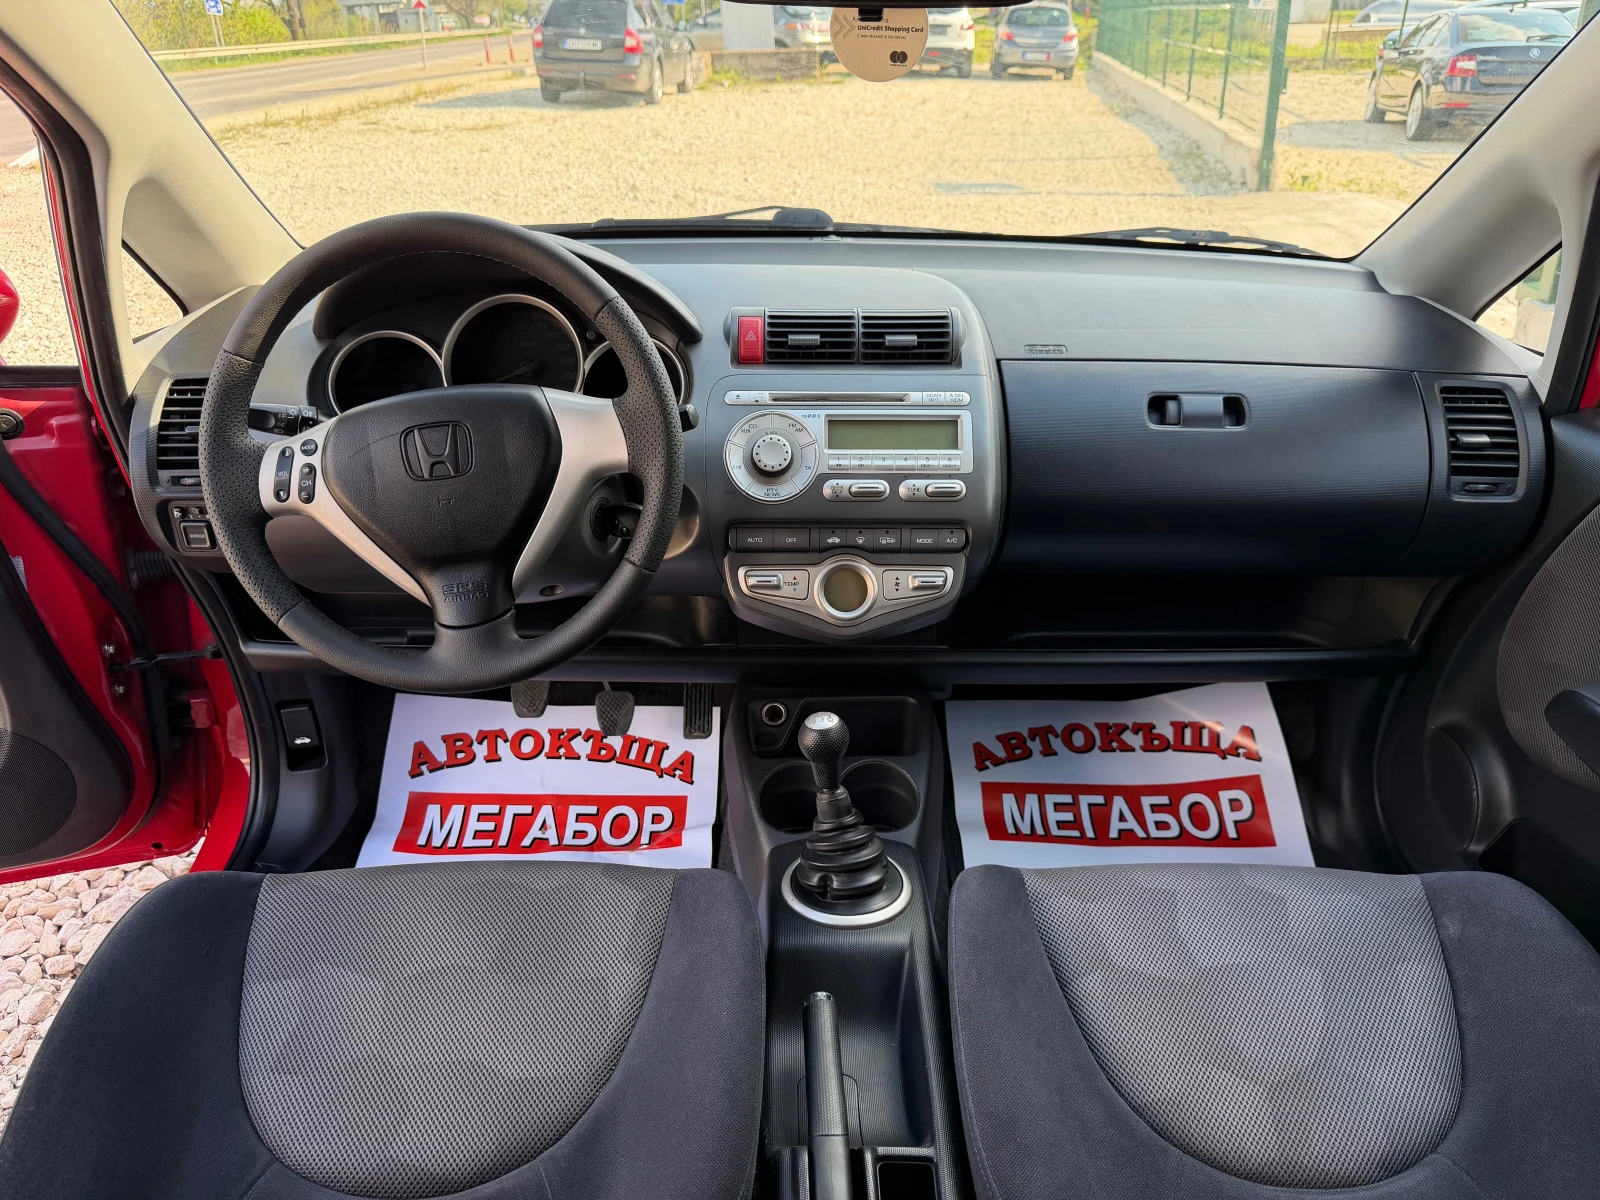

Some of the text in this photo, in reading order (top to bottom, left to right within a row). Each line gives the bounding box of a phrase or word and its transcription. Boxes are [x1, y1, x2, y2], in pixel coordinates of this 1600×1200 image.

[884, 25, 910, 33] Shopping
[408, 728, 694, 784] АВТОКЪЩА
[972, 721, 1262, 771] АВТОКЪЩА
[417, 804, 674, 849] МЕГАБОР
[1002, 789, 1254, 840] МЕГАБОР
